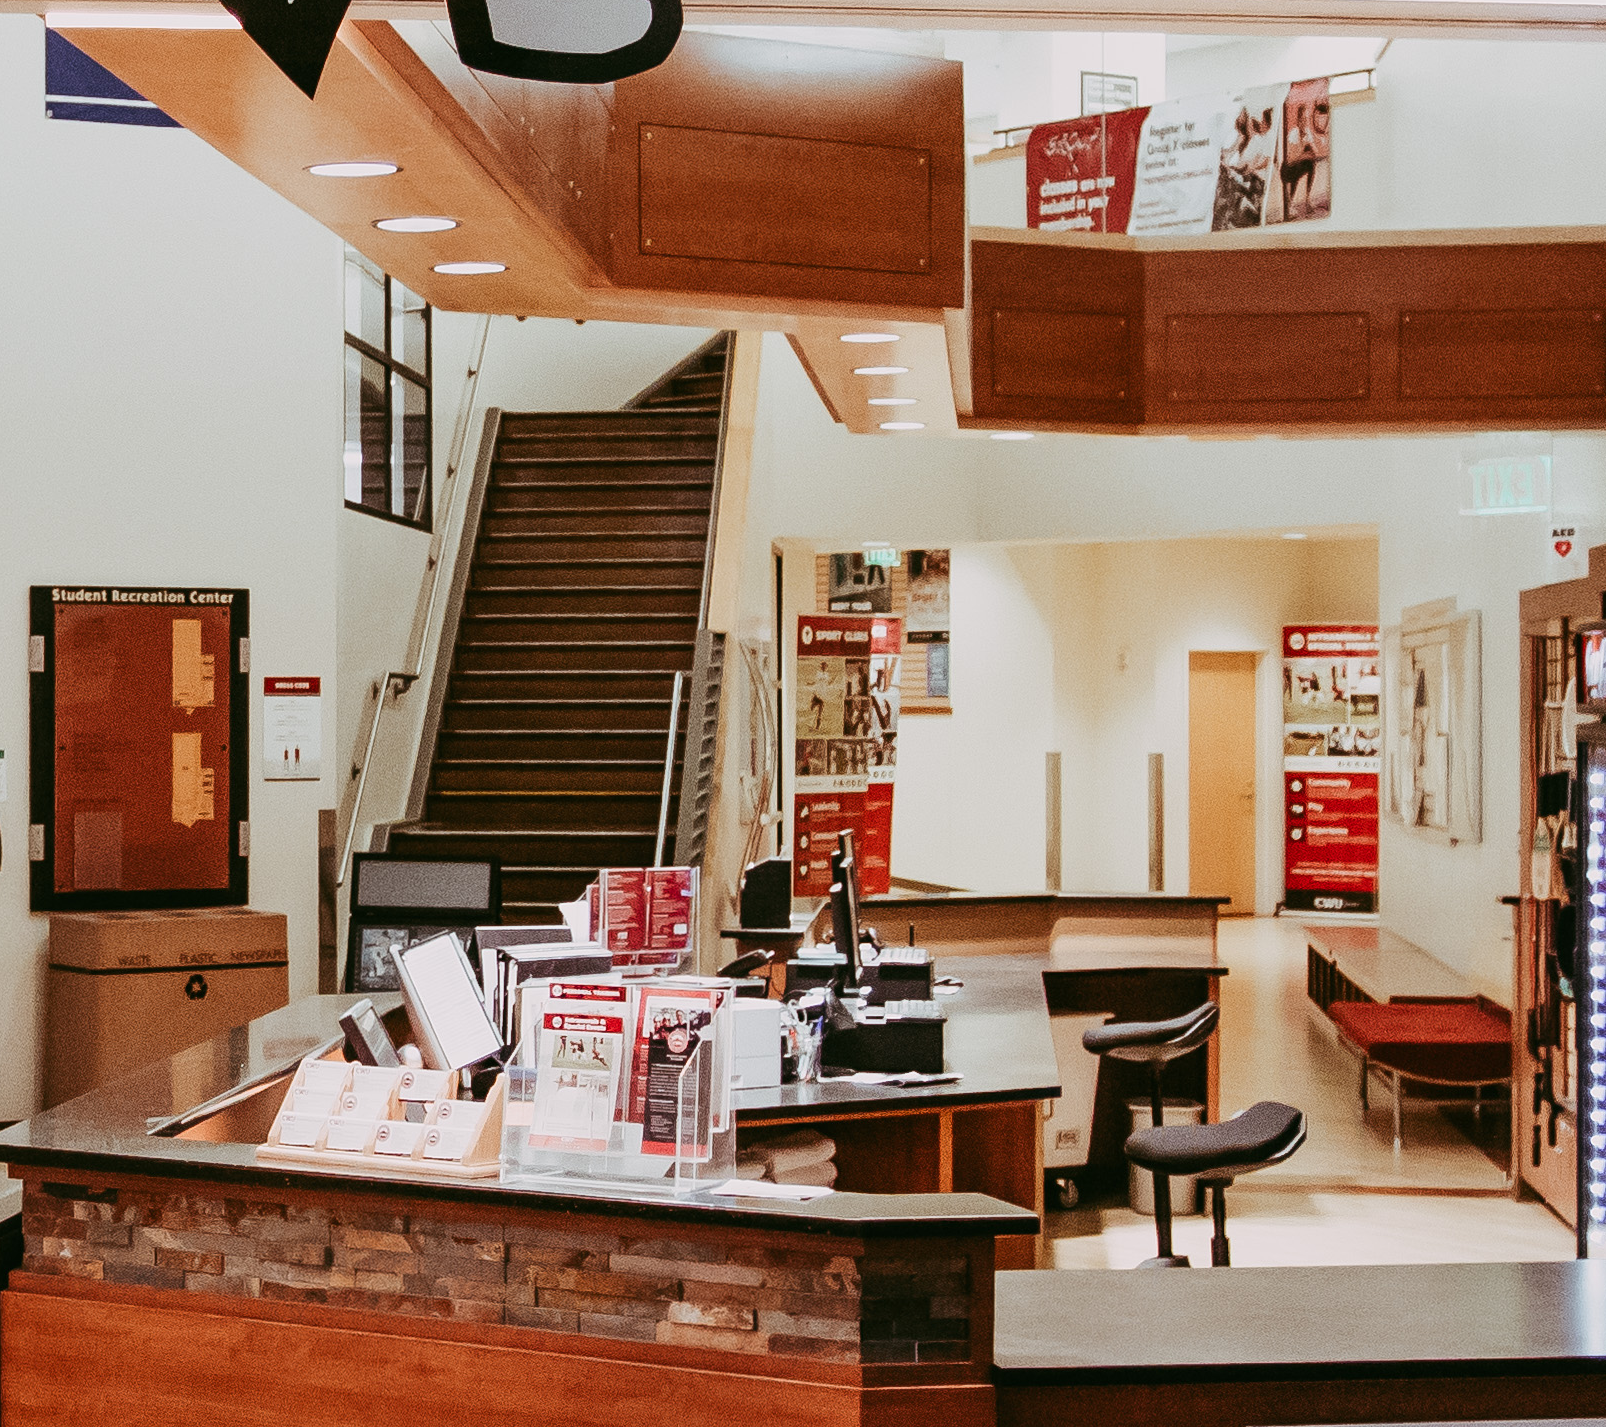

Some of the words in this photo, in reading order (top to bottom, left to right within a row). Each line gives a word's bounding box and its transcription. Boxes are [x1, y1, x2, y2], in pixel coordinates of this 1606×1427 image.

[1552, 528, 1576, 538] AED
[52, 588, 107, 603] Student
[112, 589, 185, 603] Recreation
[189, 591, 234, 604] Center
